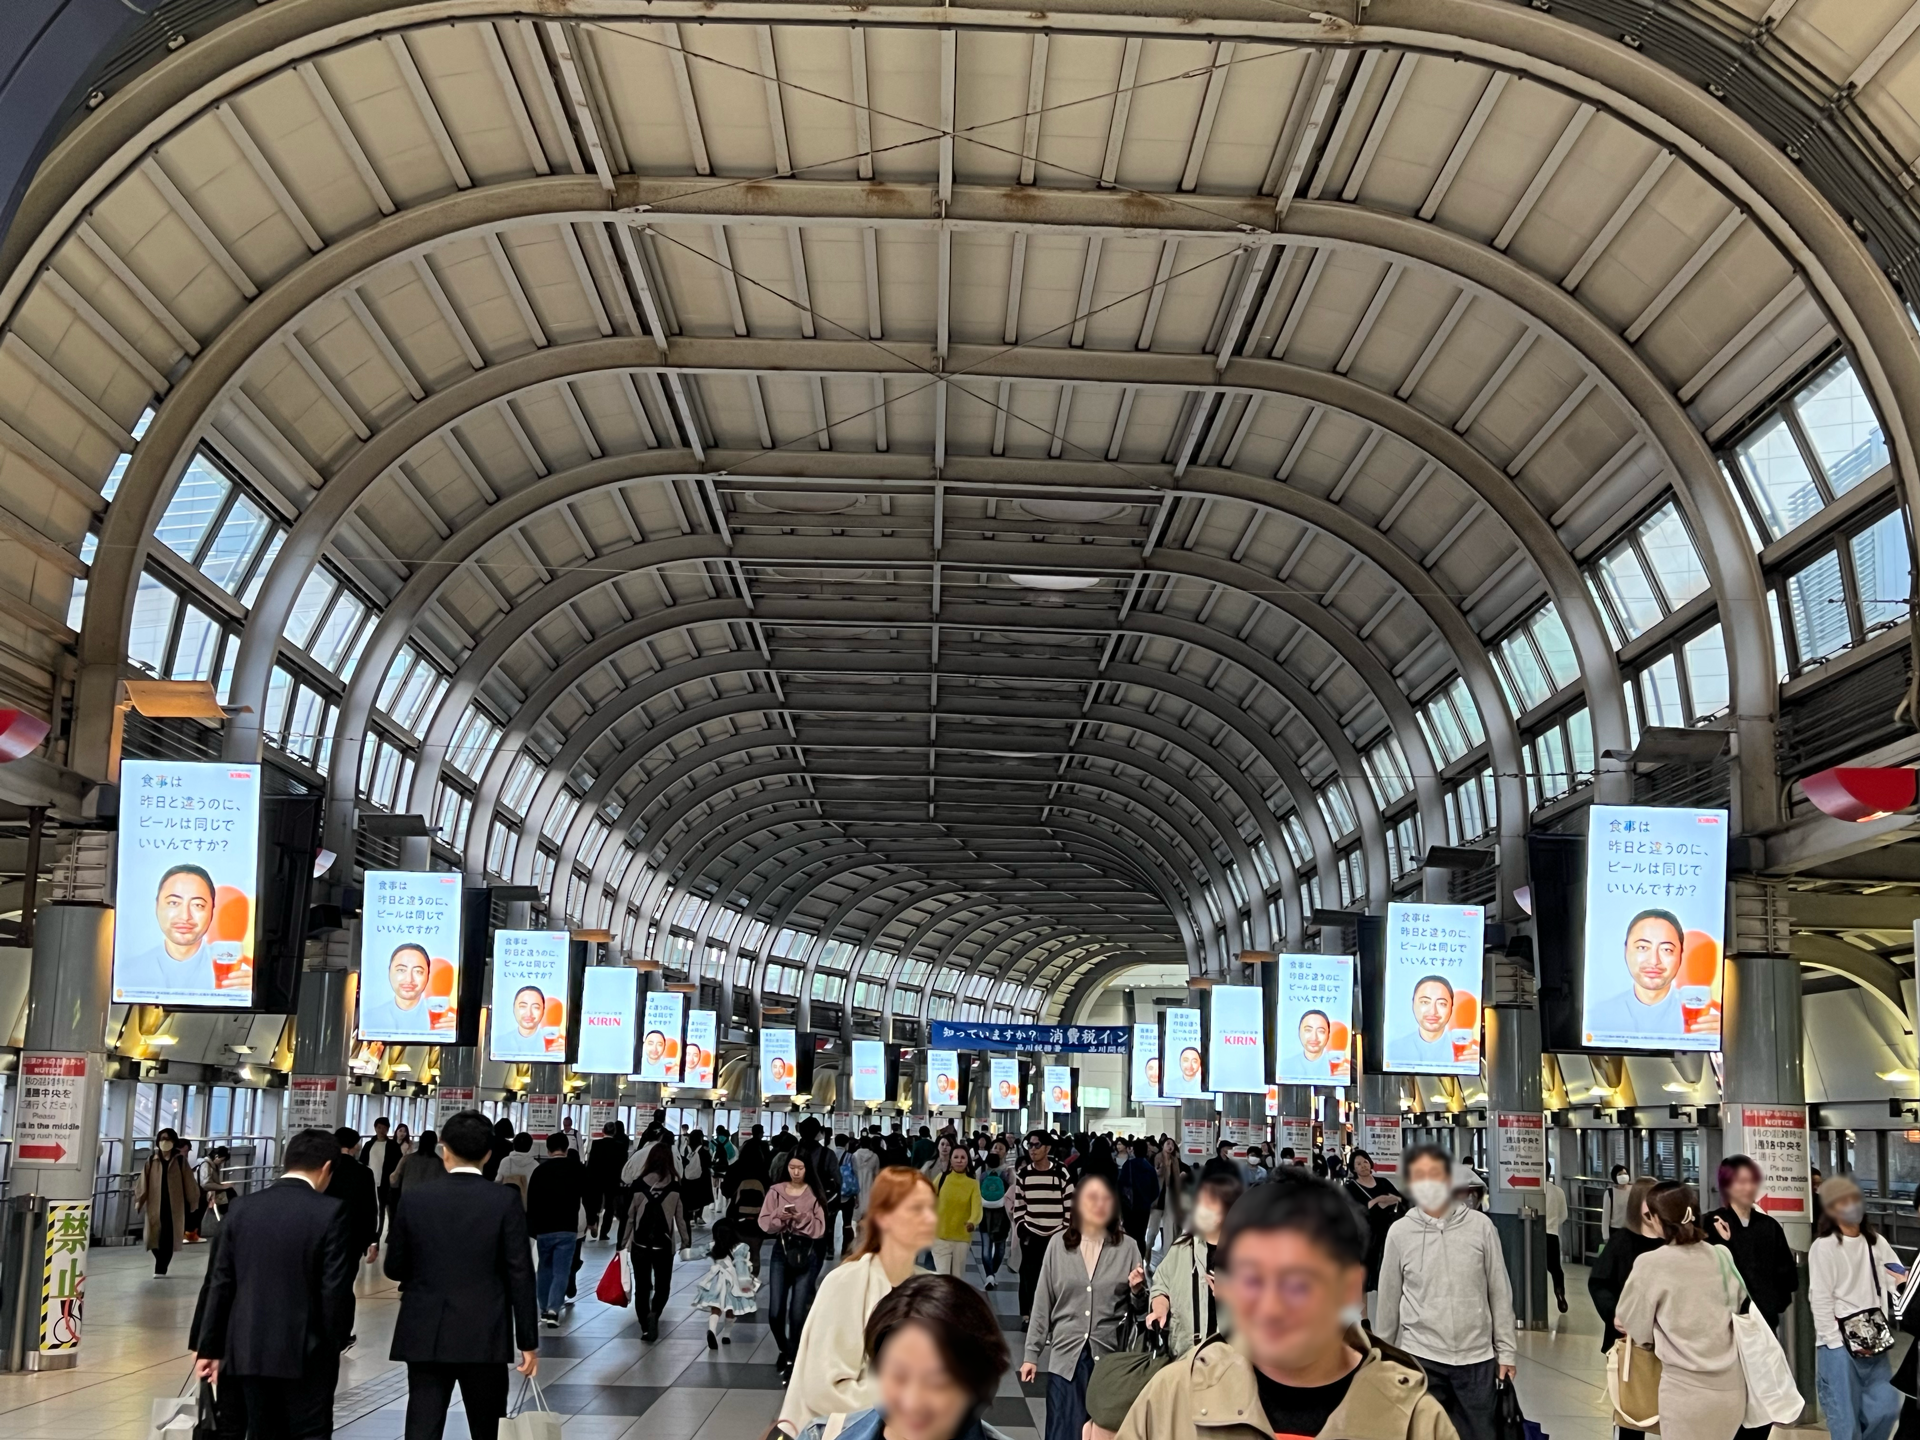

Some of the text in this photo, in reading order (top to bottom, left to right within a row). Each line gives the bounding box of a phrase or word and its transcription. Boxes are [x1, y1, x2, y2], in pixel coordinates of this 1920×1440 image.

[141, 774, 182, 788] 食事は
[140, 795, 241, 811] 昨日と違うのに、
[140, 816, 235, 831] ビールは同じで
[1610, 820, 1650, 833] 食事は
[139, 838, 228, 852] いいんですか?
[1609, 840, 1708, 856] 昨日と違うのに、
[1608, 861, 1702, 876] ビールは同じで
[1608, 883, 1696, 896] いいんですか?
[588, 1016, 620, 1026] KIRIN
[943, 1026, 1036, 1041] 知っていますか?
[1050, 1028, 1128, 1044] 消費税イン
[1224, 1036, 1256, 1046] KIRIN
[1766, 1118, 1794, 1126] NOTICE
[53, 1212, 88, 1300] 禁止
